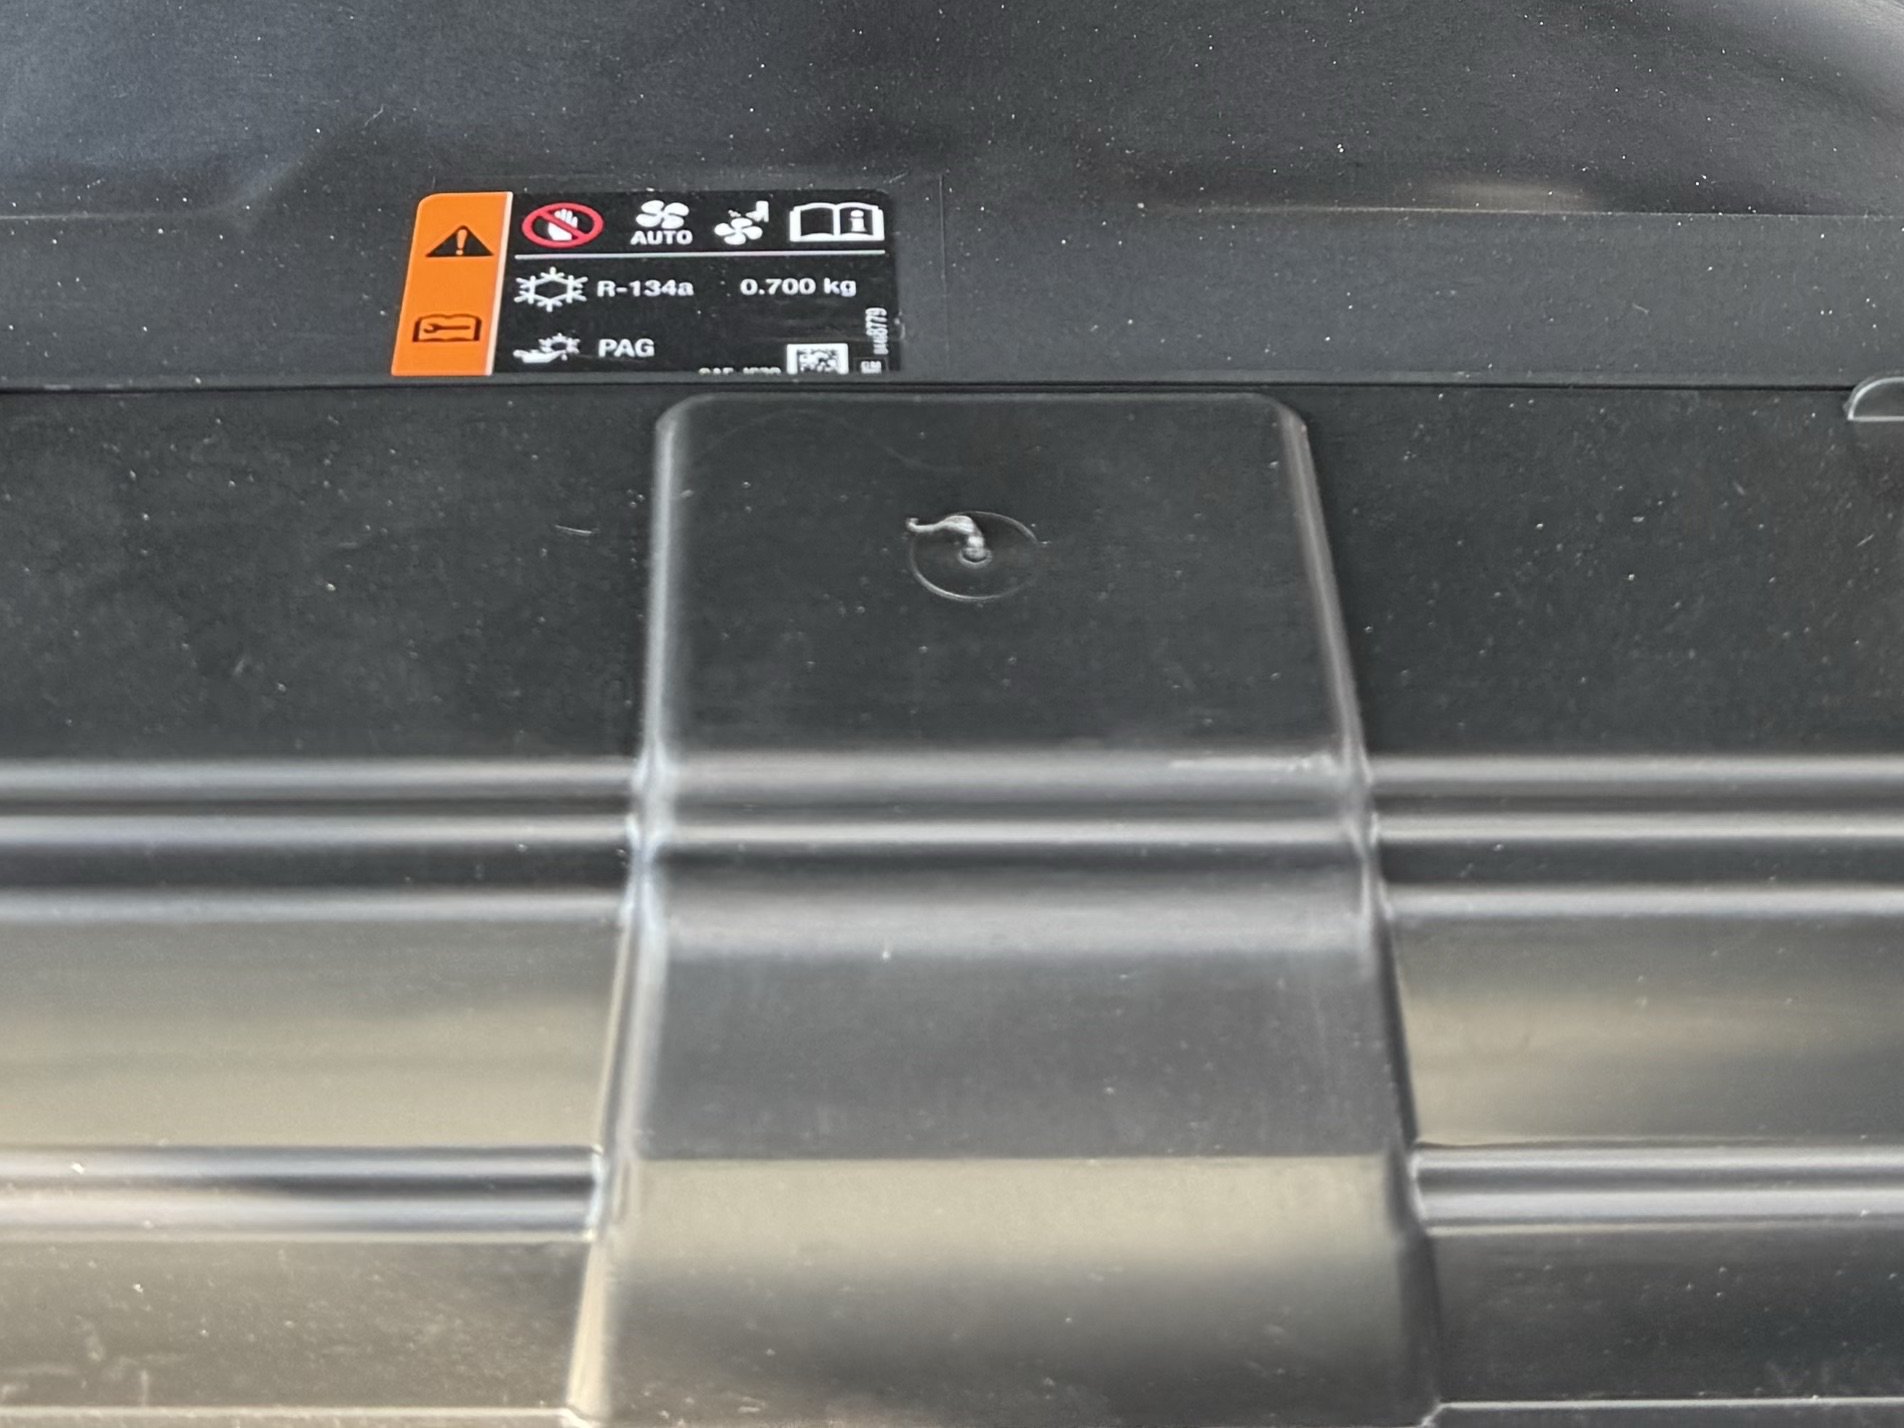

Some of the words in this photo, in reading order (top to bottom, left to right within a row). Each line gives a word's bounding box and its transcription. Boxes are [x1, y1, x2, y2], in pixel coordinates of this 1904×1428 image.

[630, 230, 693, 245] AUTO
[596, 279, 695, 297] R-134a
[739, 278, 816, 297] 0.700
[823, 278, 857, 298] kg
[598, 338, 655, 358] PAG
